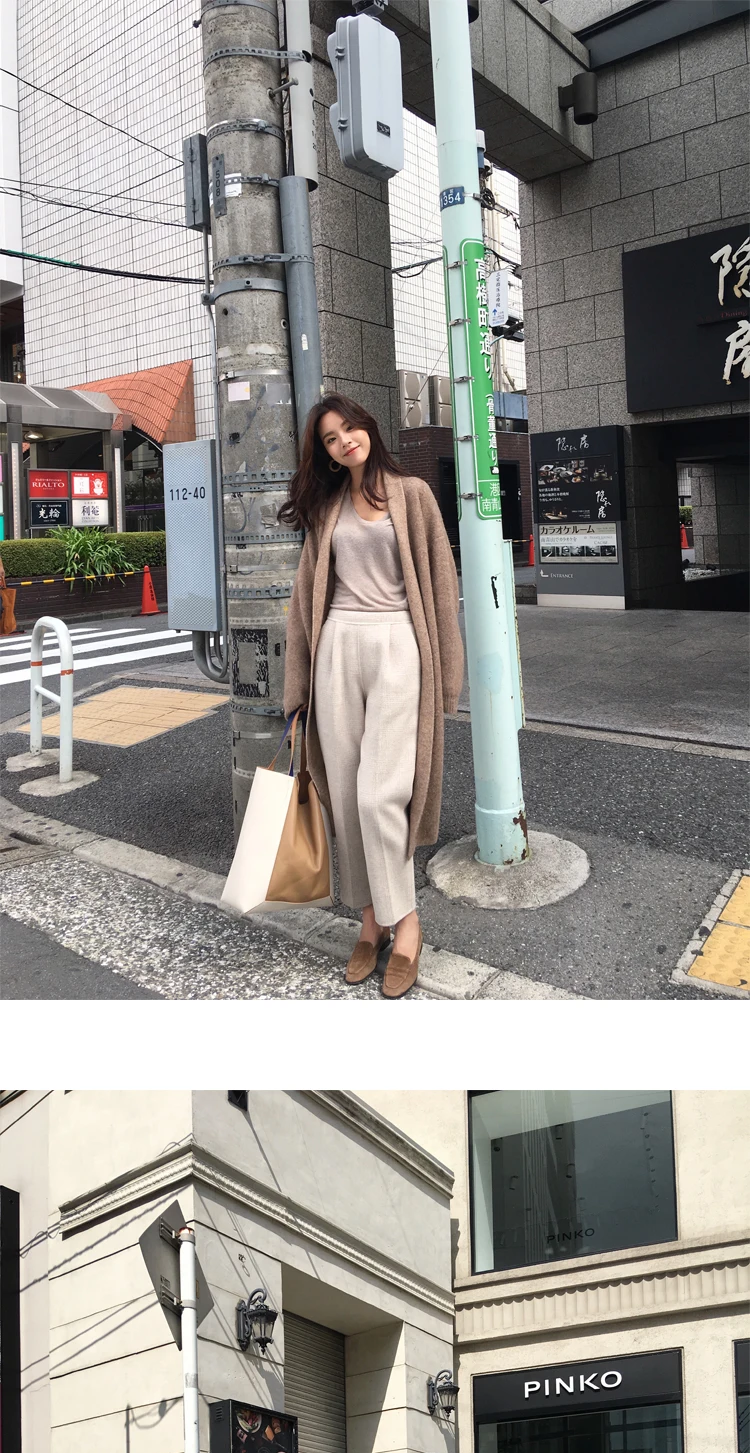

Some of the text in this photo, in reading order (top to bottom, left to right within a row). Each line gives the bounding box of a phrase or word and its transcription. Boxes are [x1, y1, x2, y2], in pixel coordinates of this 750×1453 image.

[169, 486, 206, 501] 112-40
[540, 524, 595, 535] カラオケルーム
[546, 1228, 595, 1244] PINKO
[524, 1370, 623, 1399] PINKO
